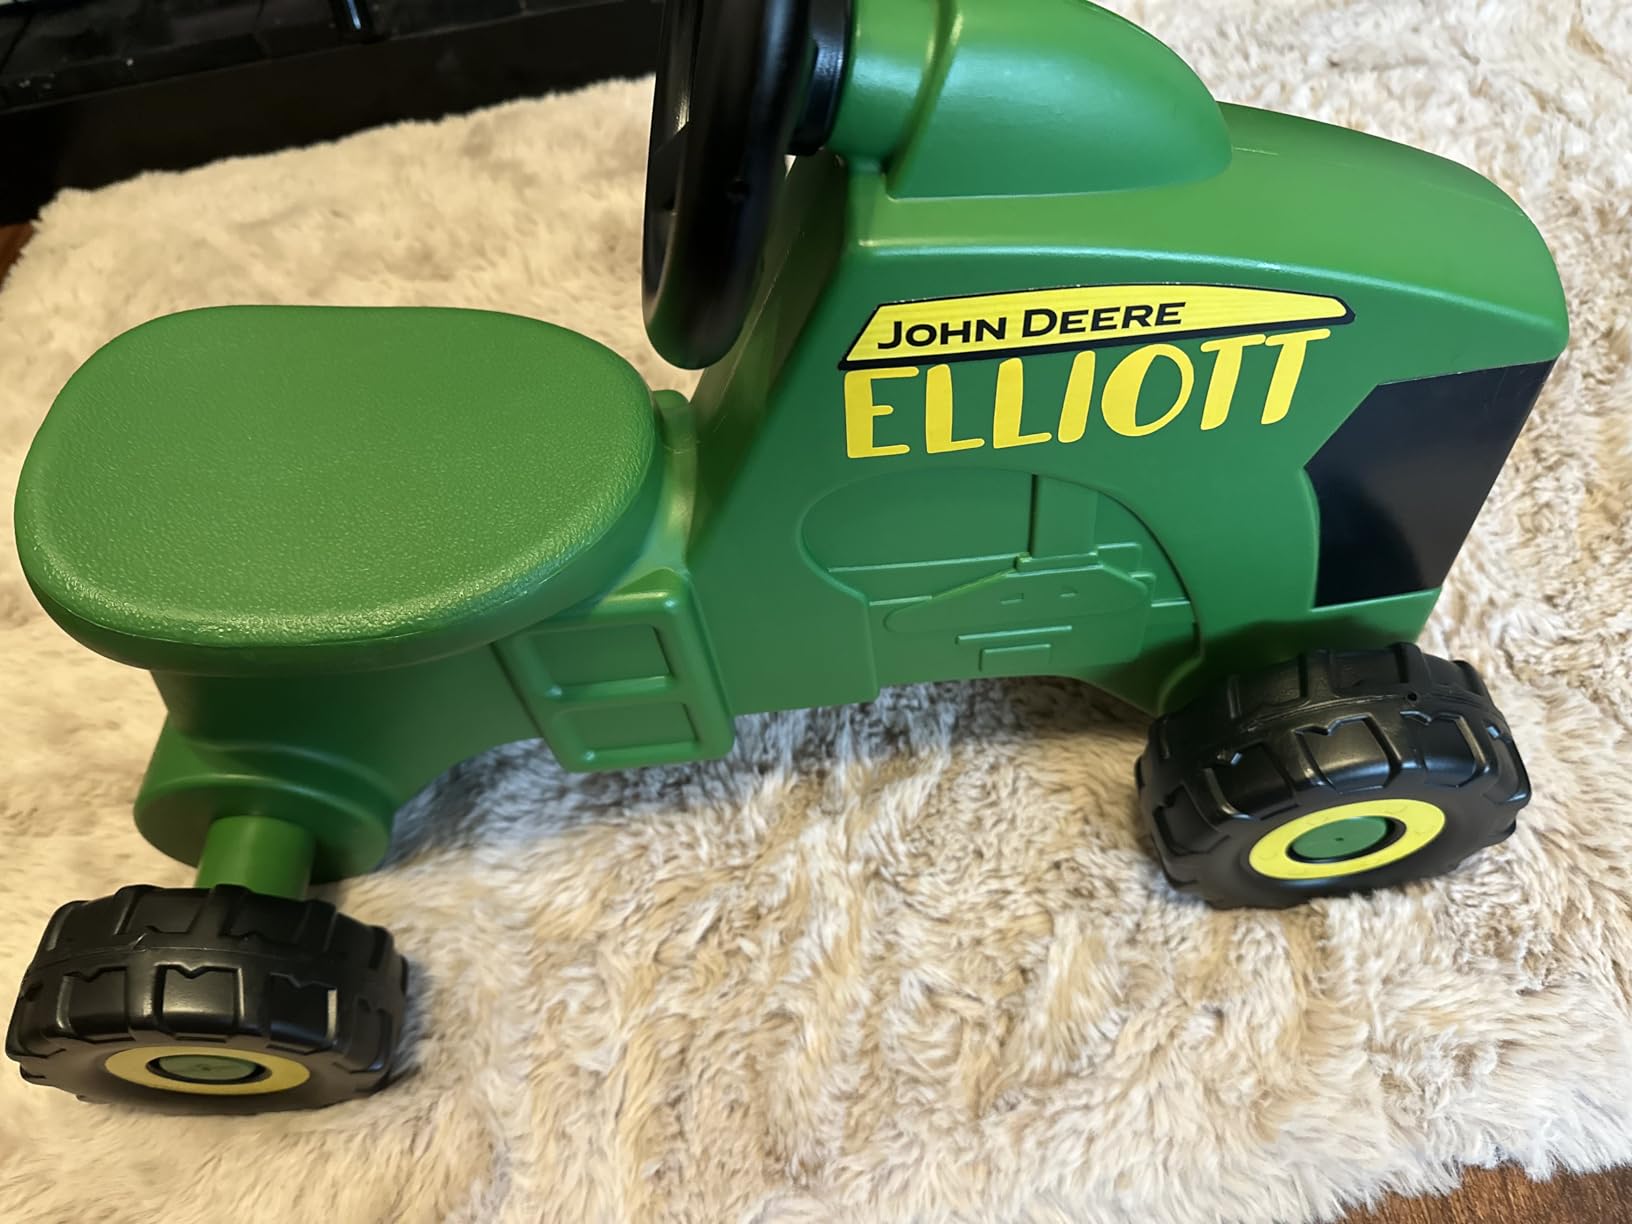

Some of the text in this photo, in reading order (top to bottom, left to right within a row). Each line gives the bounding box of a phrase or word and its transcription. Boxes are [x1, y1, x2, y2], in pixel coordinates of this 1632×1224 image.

[877, 302, 1186, 350] JOHN DEERE
[844, 328, 1331, 458] ELLIOTT
